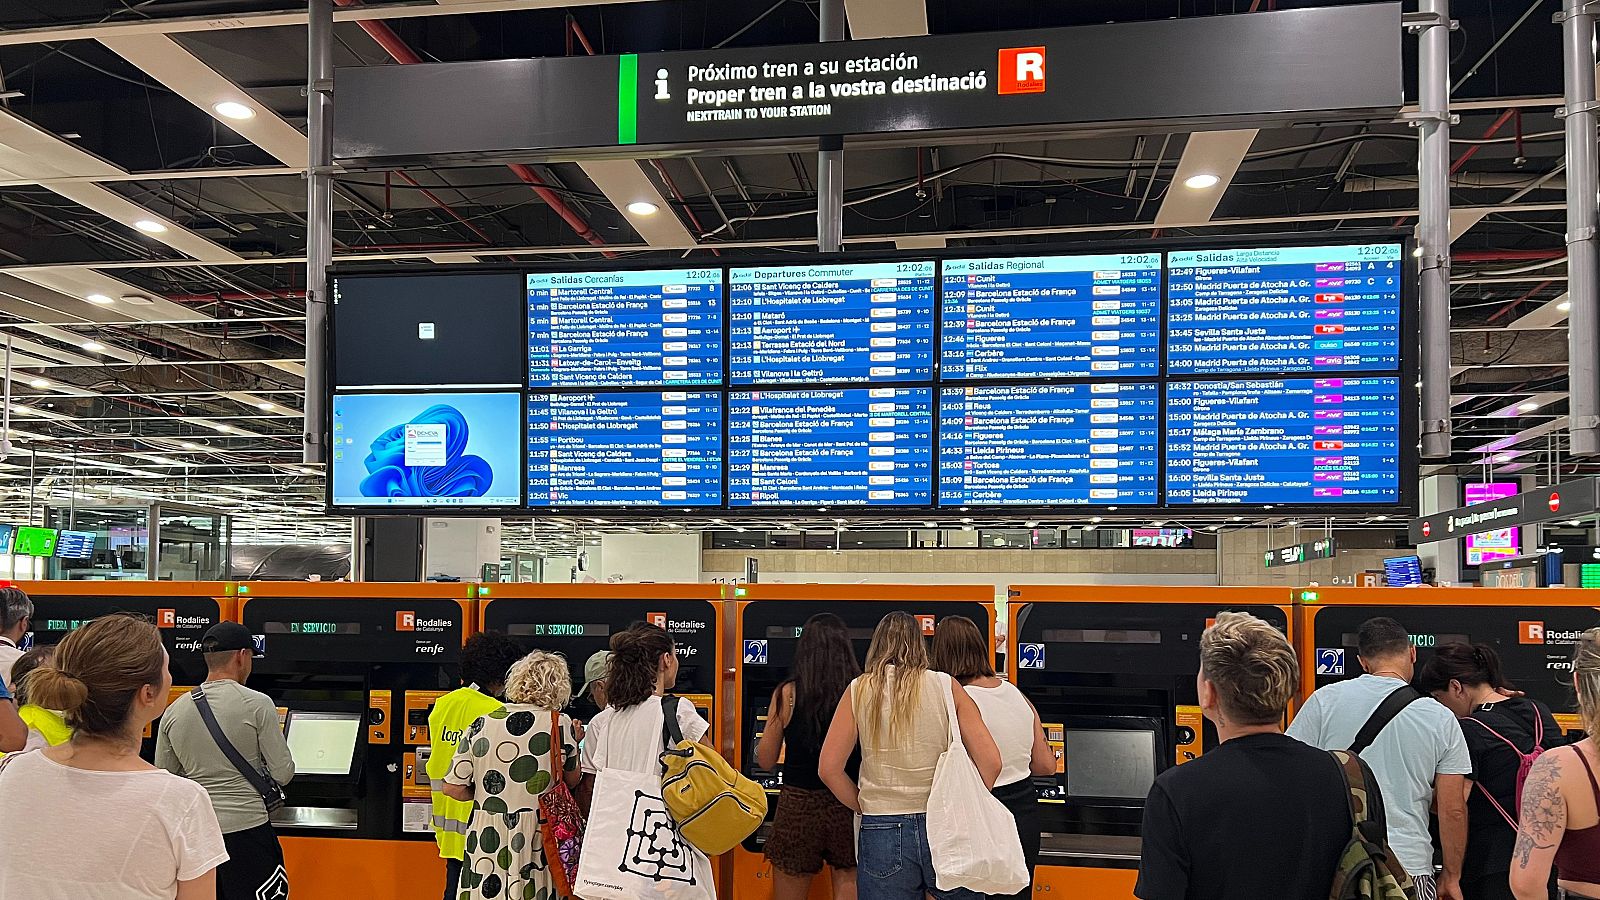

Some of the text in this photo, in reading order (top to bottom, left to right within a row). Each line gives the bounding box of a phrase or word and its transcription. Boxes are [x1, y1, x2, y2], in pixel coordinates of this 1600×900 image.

[688, 52, 918, 82] Próximo tren a su estación
[1017, 53, 1043, 81] R
[687, 71, 987, 107] Proper tren a la vostra destinació
[745, 108, 757, 118] TO
[760, 106, 788, 118] YOUR
[790, 104, 831, 116] STATION
[1196, 254, 1234, 262] Salidas
[969, 262, 1004, 270] Salidas
[1006, 261, 1044, 270] Regional
[1195, 266, 1260, 276] Figueres-Vilafant
[1367, 262, 1374, 270] A
[585, 275, 623, 283] Cercanías
[755, 270, 806, 280] Departures
[808, 269, 853, 277] Commuter
[1171, 283, 1193, 291] 12:50
[813, 296, 845, 304] Llobregat
[592, 301, 615, 309] Estació
[626, 301, 648, 309] França
[567, 345, 592, 353] Garriga
[1194, 382, 1246, 390] Donostia/San
[1248, 381, 1284, 389] Sebastián
[1194, 428, 1218, 436] Málaga
[760, 492, 779, 500] Ripoll
[164, 612, 174, 623] R
[403, 614, 414, 626] R
[48, 620, 67, 629] FUERA
[416, 619, 452, 627] Rodalies
[922, 618, 934, 630] R
[291, 623, 336, 633] EN SERVICIO
[536, 625, 583, 634] EN SERVICIO
[1529, 625, 1543, 638] R
[1546, 631, 1584, 639] Rodali
[176, 640, 202, 652] renfe
[416, 644, 444, 655] renfe
[675, 646, 697, 658] enfe
